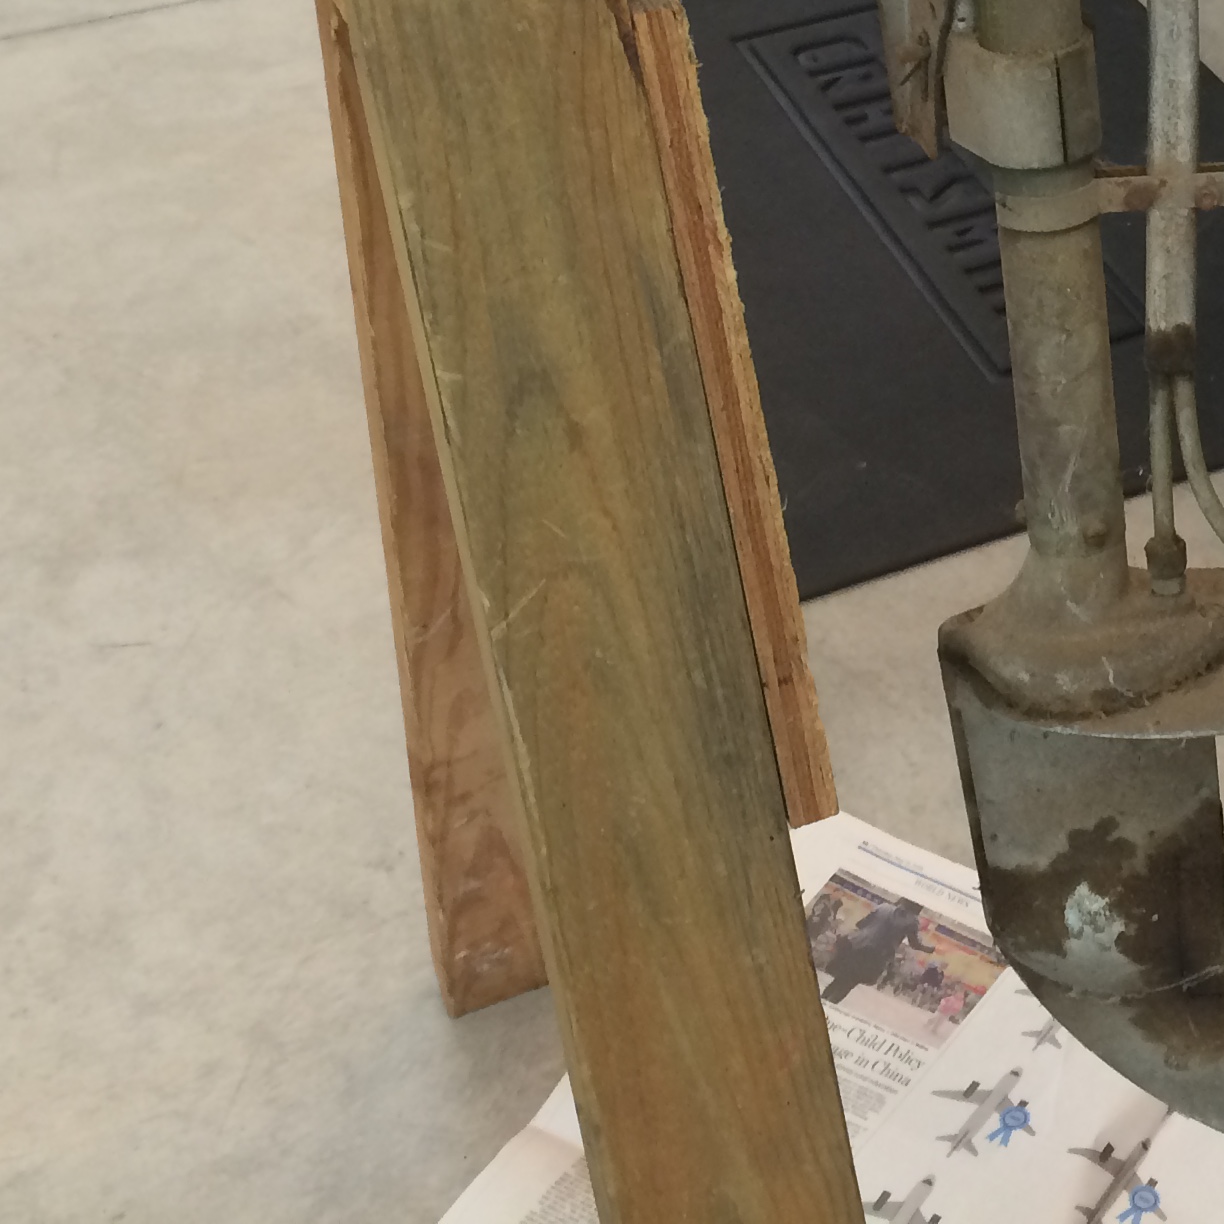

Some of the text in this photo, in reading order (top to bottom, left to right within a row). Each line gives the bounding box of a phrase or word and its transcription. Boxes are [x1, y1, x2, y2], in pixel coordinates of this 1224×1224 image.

[825, 1016, 887, 1053] ne-Child
[883, 1042, 926, 1072] Policy
[870, 1060, 912, 1088] China
